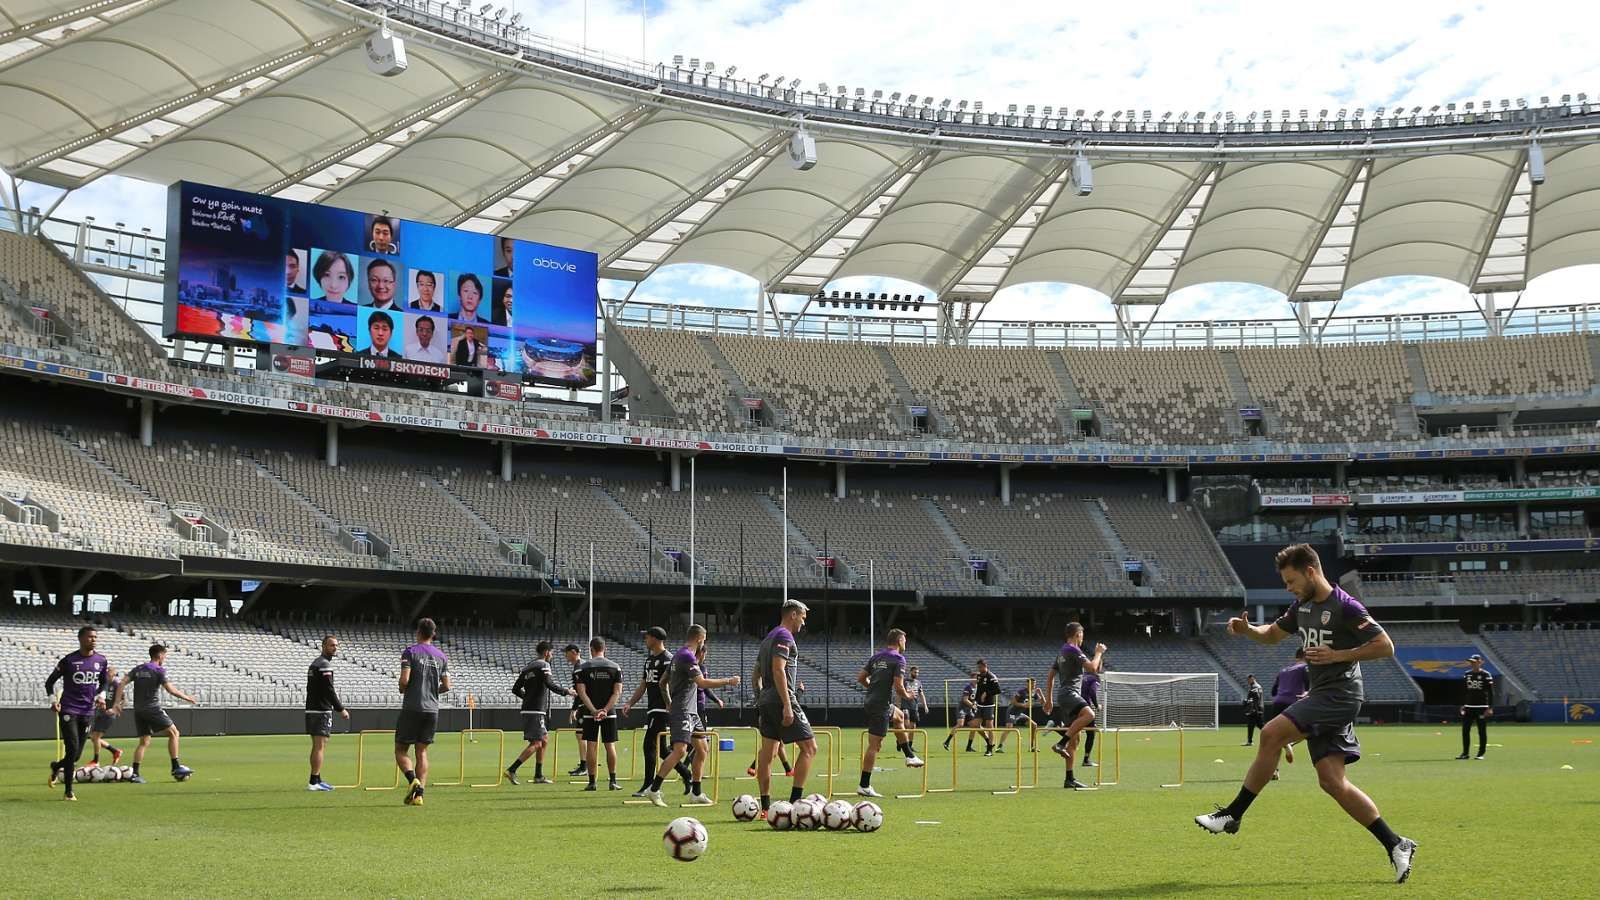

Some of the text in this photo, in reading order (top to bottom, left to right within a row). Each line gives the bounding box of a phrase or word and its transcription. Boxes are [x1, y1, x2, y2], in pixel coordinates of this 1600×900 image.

[221, 201, 241, 210] goin
[242, 205, 263, 215] mate
[532, 256, 577, 273] abbvie
[59, 366, 90, 379] EAGLES
[136, 379, 166, 392] BETTER
[167, 384, 194, 397] MUSIC
[210, 391, 271, 406] & MORE OF IT
[385, 414, 443, 427] & MORE OF IT
[552, 431, 558, 439] &
[559, 432, 585, 441] MORE
[599, 434, 608, 442] IT
[722, 444, 746, 452] MORE
[760, 445, 769, 453] IT
[1455, 543, 1488, 552] CLUB
[72, 671, 101, 685] QBE
